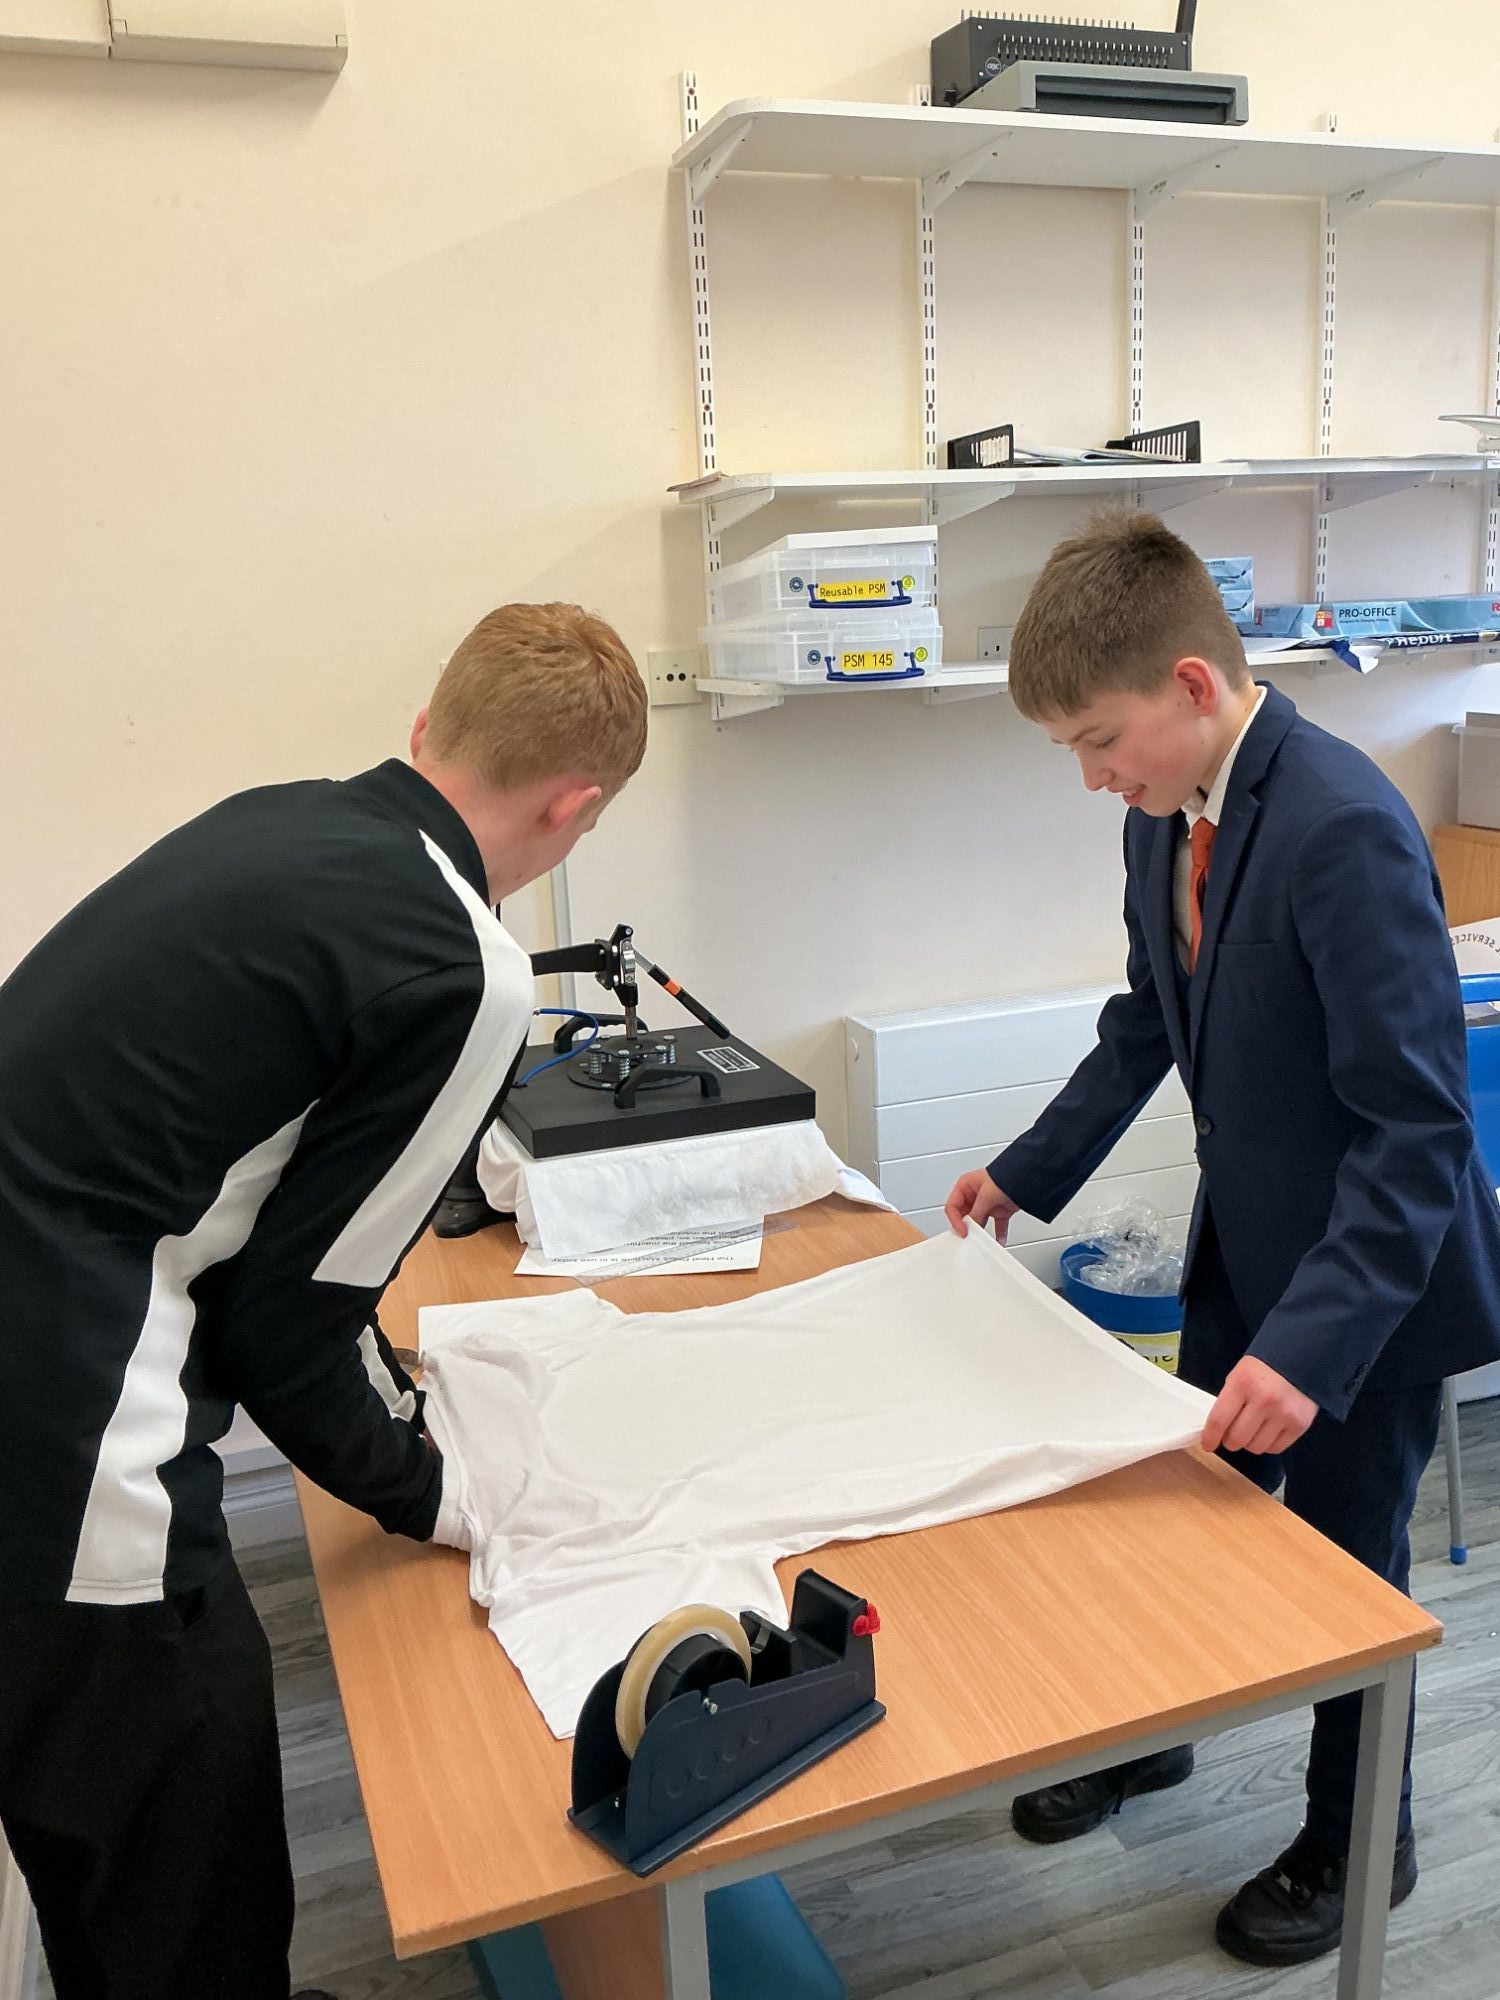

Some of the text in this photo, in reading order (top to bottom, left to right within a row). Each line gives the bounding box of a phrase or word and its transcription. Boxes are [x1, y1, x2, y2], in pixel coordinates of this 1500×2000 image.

[820, 583, 886, 597] Reusable PSM
[1339, 606, 1397, 618] PRO-OFFICE
[843, 653, 893, 667] PSM 145
